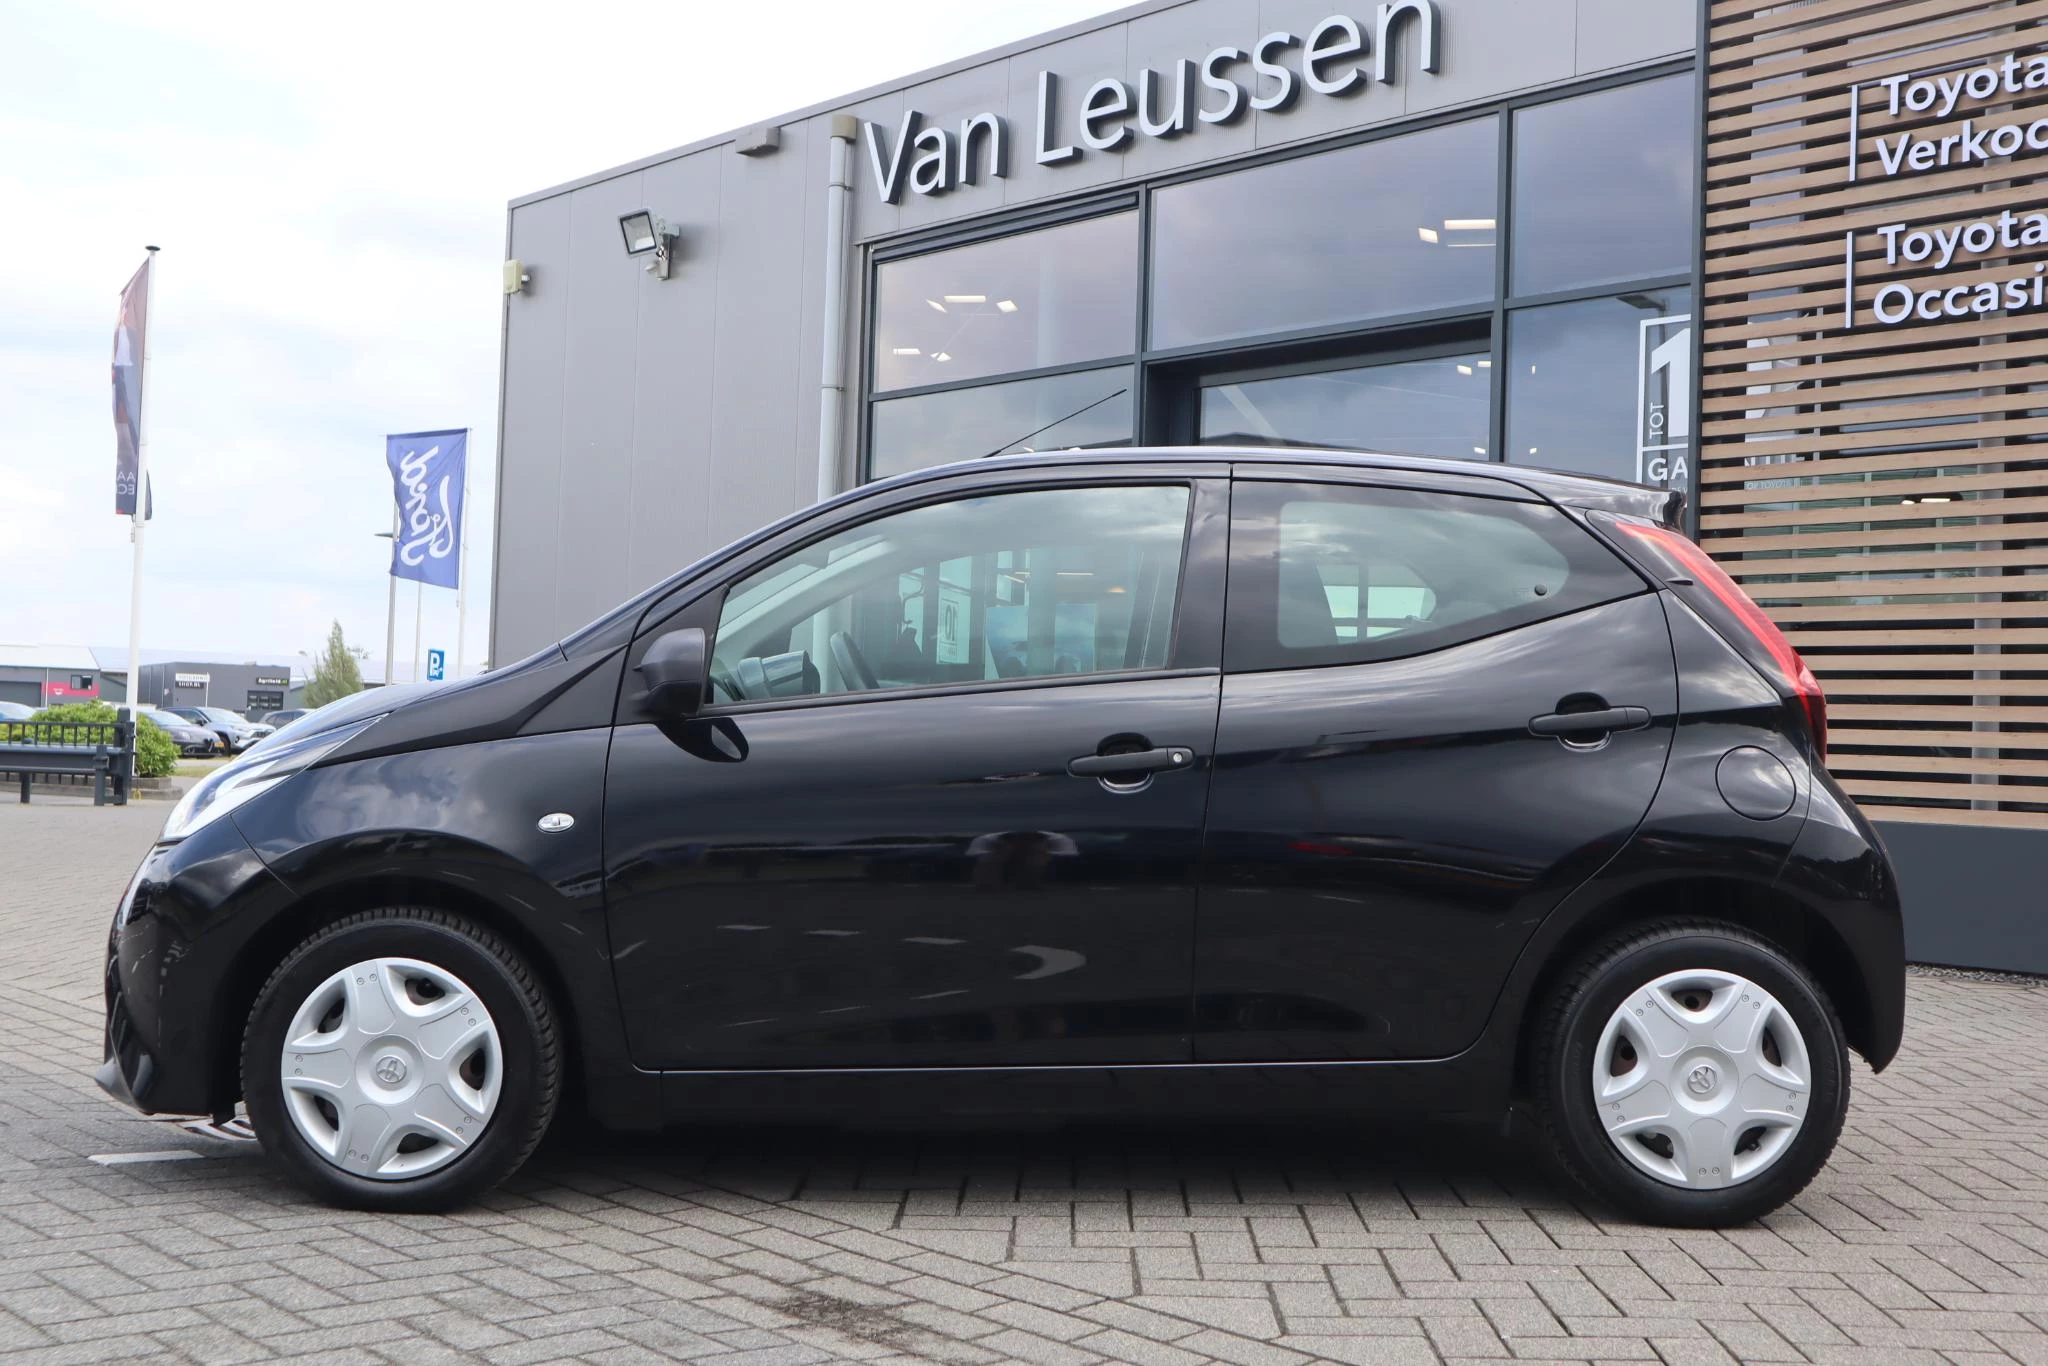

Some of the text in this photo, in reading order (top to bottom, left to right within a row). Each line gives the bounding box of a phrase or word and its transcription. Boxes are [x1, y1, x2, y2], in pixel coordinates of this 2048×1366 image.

[864, 0, 1440, 204] Van Leussen
[1880, 54, 2048, 117] Toyota
[1877, 209, 2048, 269] Toyota
[1873, 263, 2046, 324] Occasi
[1649, 402, 1665, 440] TOT
